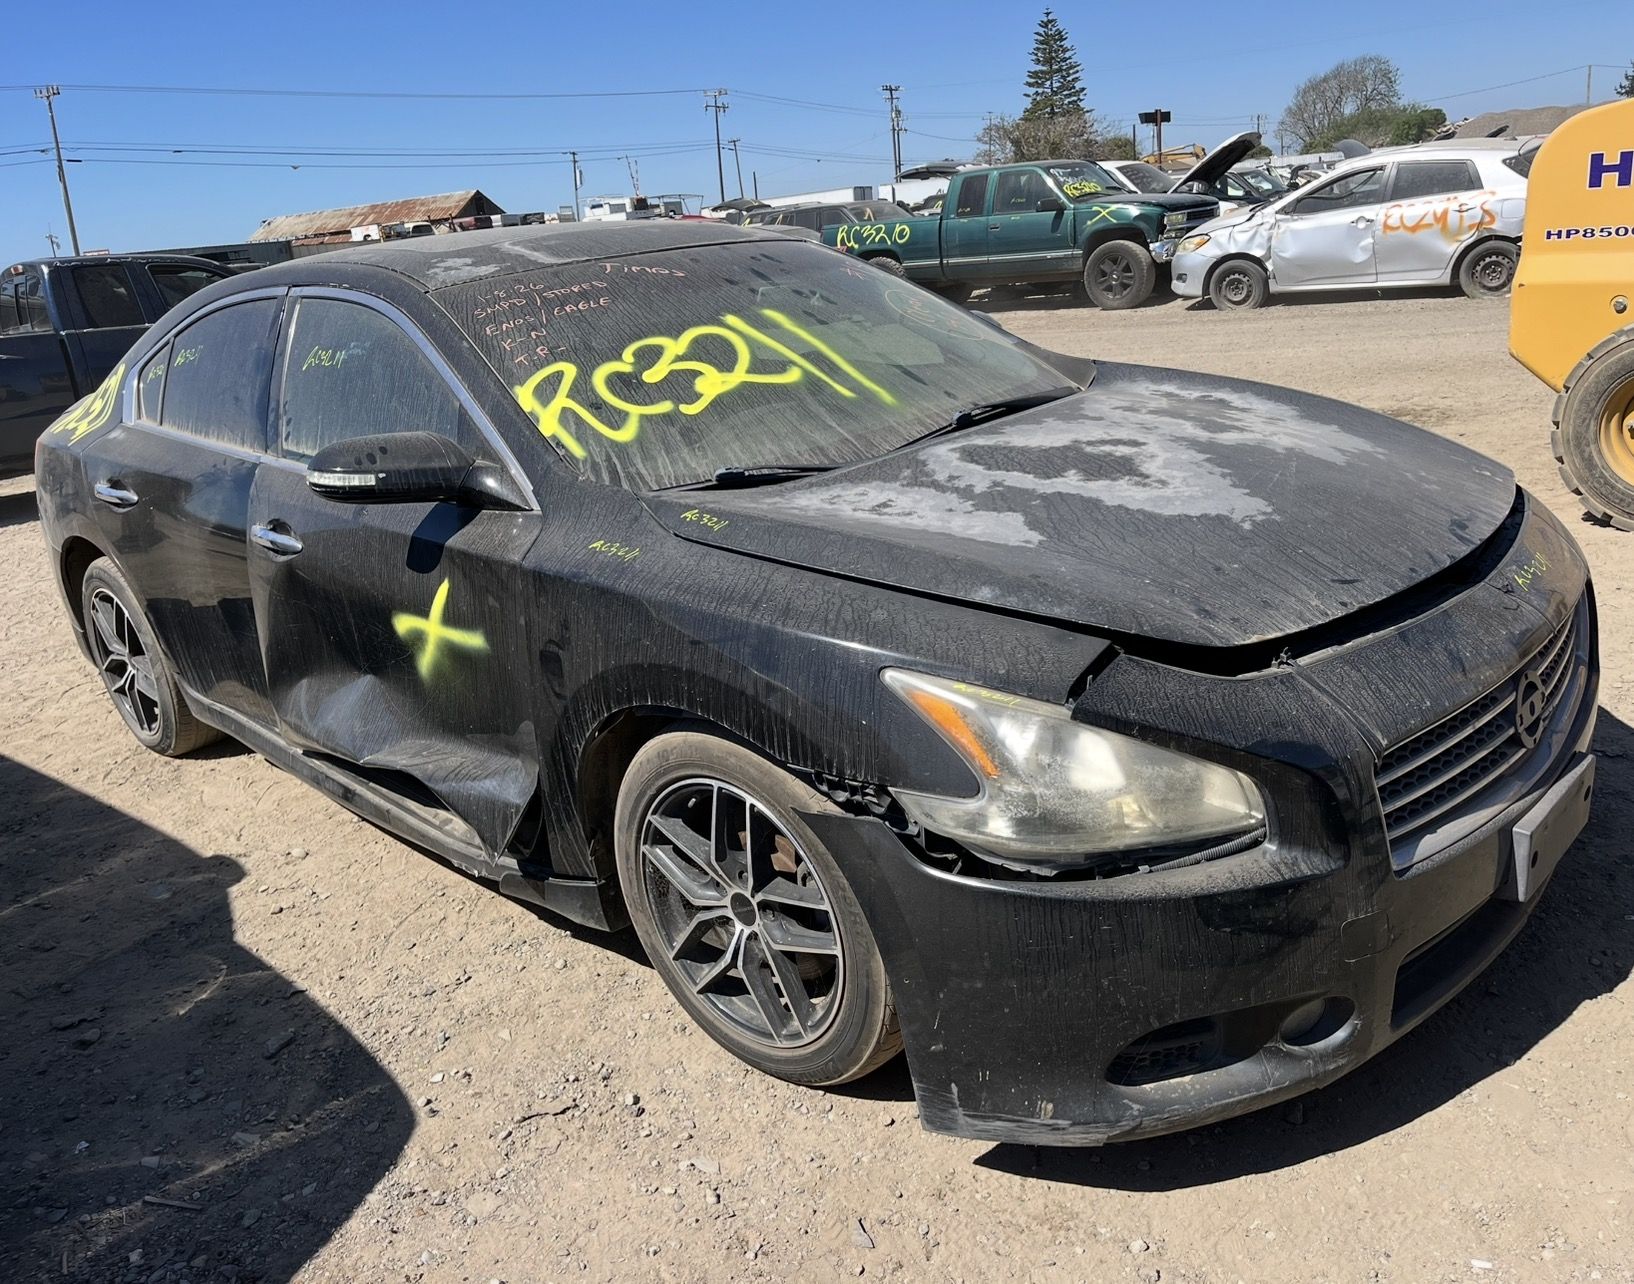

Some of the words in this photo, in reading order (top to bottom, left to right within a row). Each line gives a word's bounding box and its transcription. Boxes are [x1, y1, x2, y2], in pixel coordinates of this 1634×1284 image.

[836, 222, 911, 251] RC3210
[1544, 225, 1634, 241] HP850
[512, 307, 898, 460] RC3211
[680, 509, 729, 532] RC3211
[588, 540, 640, 562] RC3211
